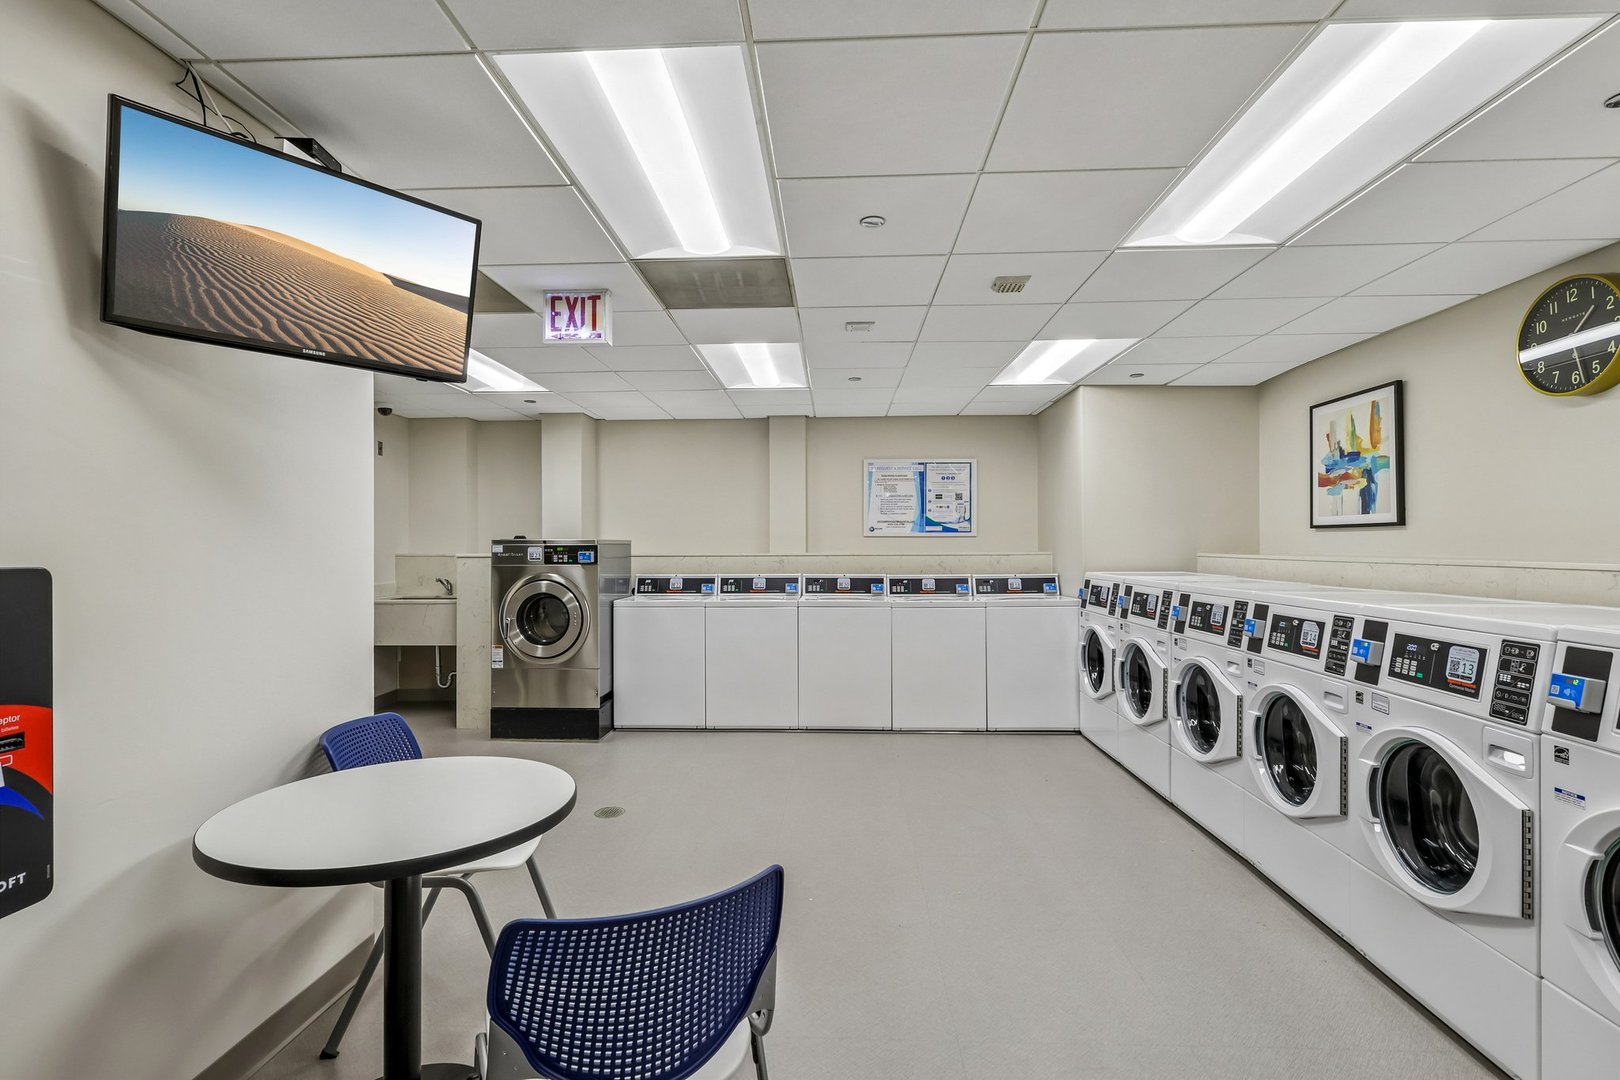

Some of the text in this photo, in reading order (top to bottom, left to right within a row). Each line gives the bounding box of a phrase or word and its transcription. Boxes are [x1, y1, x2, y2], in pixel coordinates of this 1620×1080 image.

[1566, 288, 1578, 303] 12
[1606, 295, 1615, 310] 2
[550, 295, 602, 332] EXIT
[1549, 301, 1558, 315] 11
[1536, 320, 1547, 335] 10
[1607, 340, 1616, 354] 4
[1537, 361, 1545, 374] 8
[1592, 360, 1600, 374] 5
[1552, 370, 1560, 384] 7
[1571, 371, 1580, 384] 6
[1309, 633, 1317, 642] 14
[1461, 662, 1475, 676] 13
